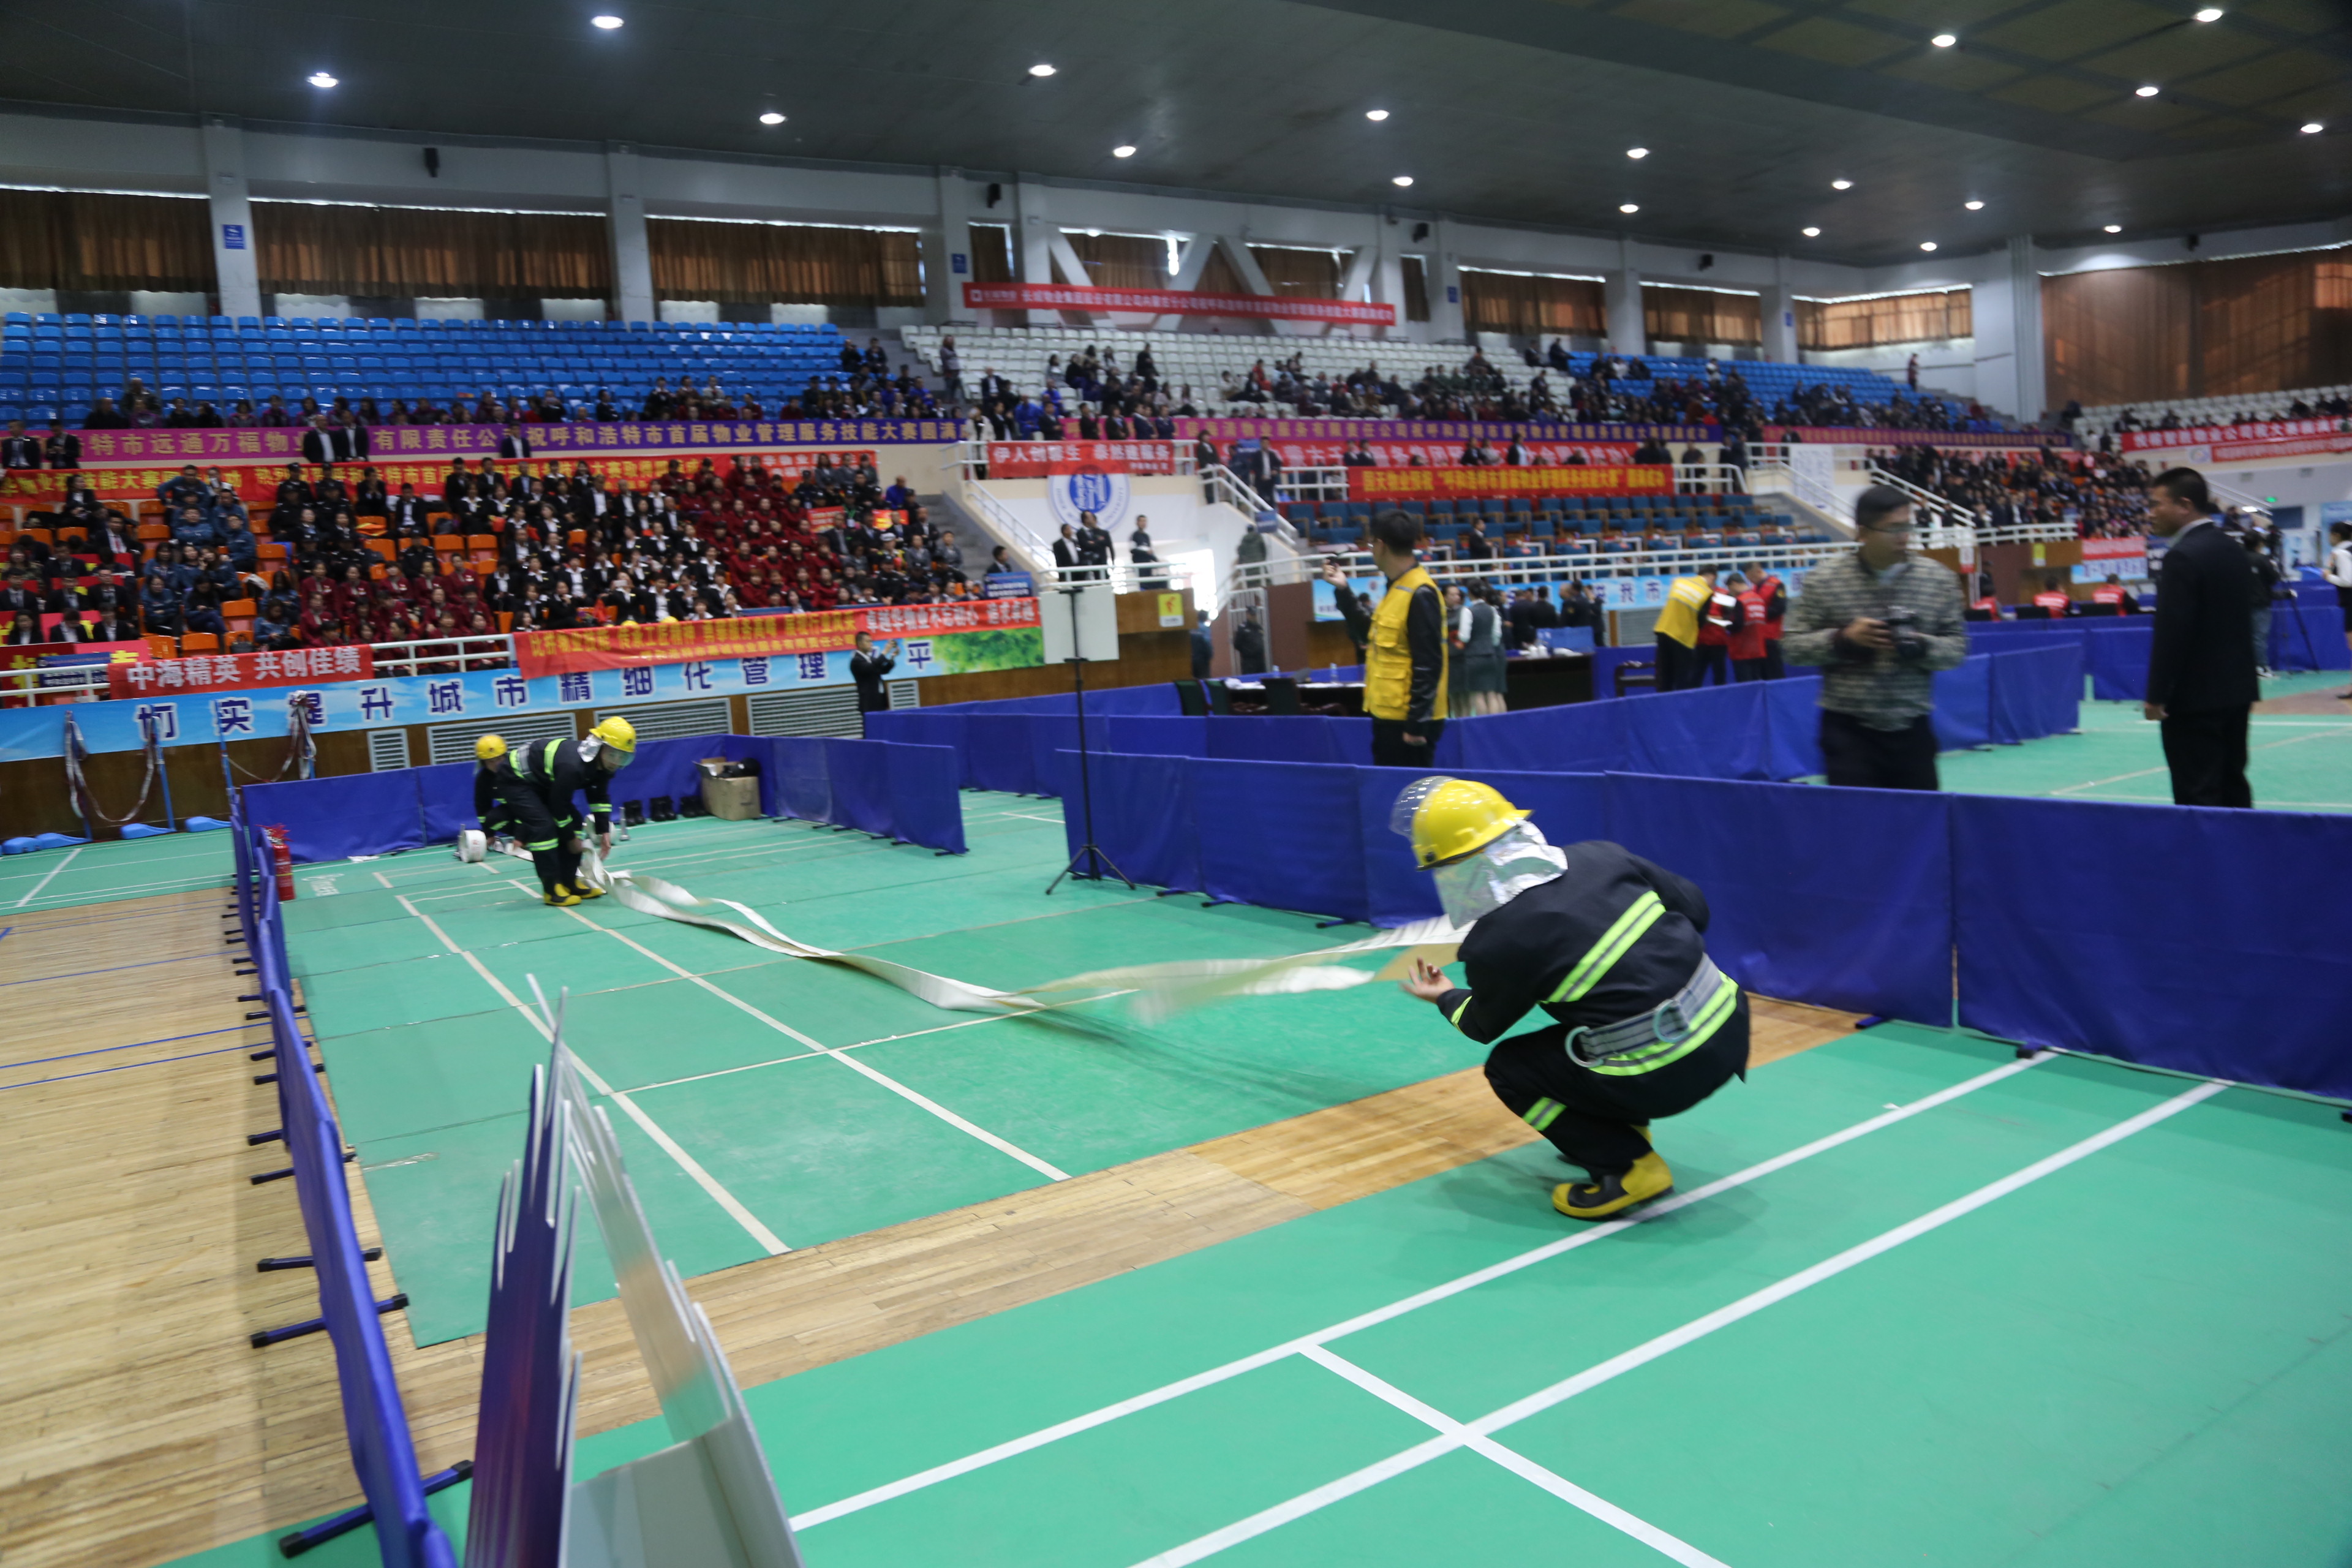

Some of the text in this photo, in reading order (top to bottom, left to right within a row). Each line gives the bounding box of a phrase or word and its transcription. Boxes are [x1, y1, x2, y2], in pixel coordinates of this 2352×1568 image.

[126, 655, 241, 690] 中海精英
[254, 646, 361, 680] 共创佳绩
